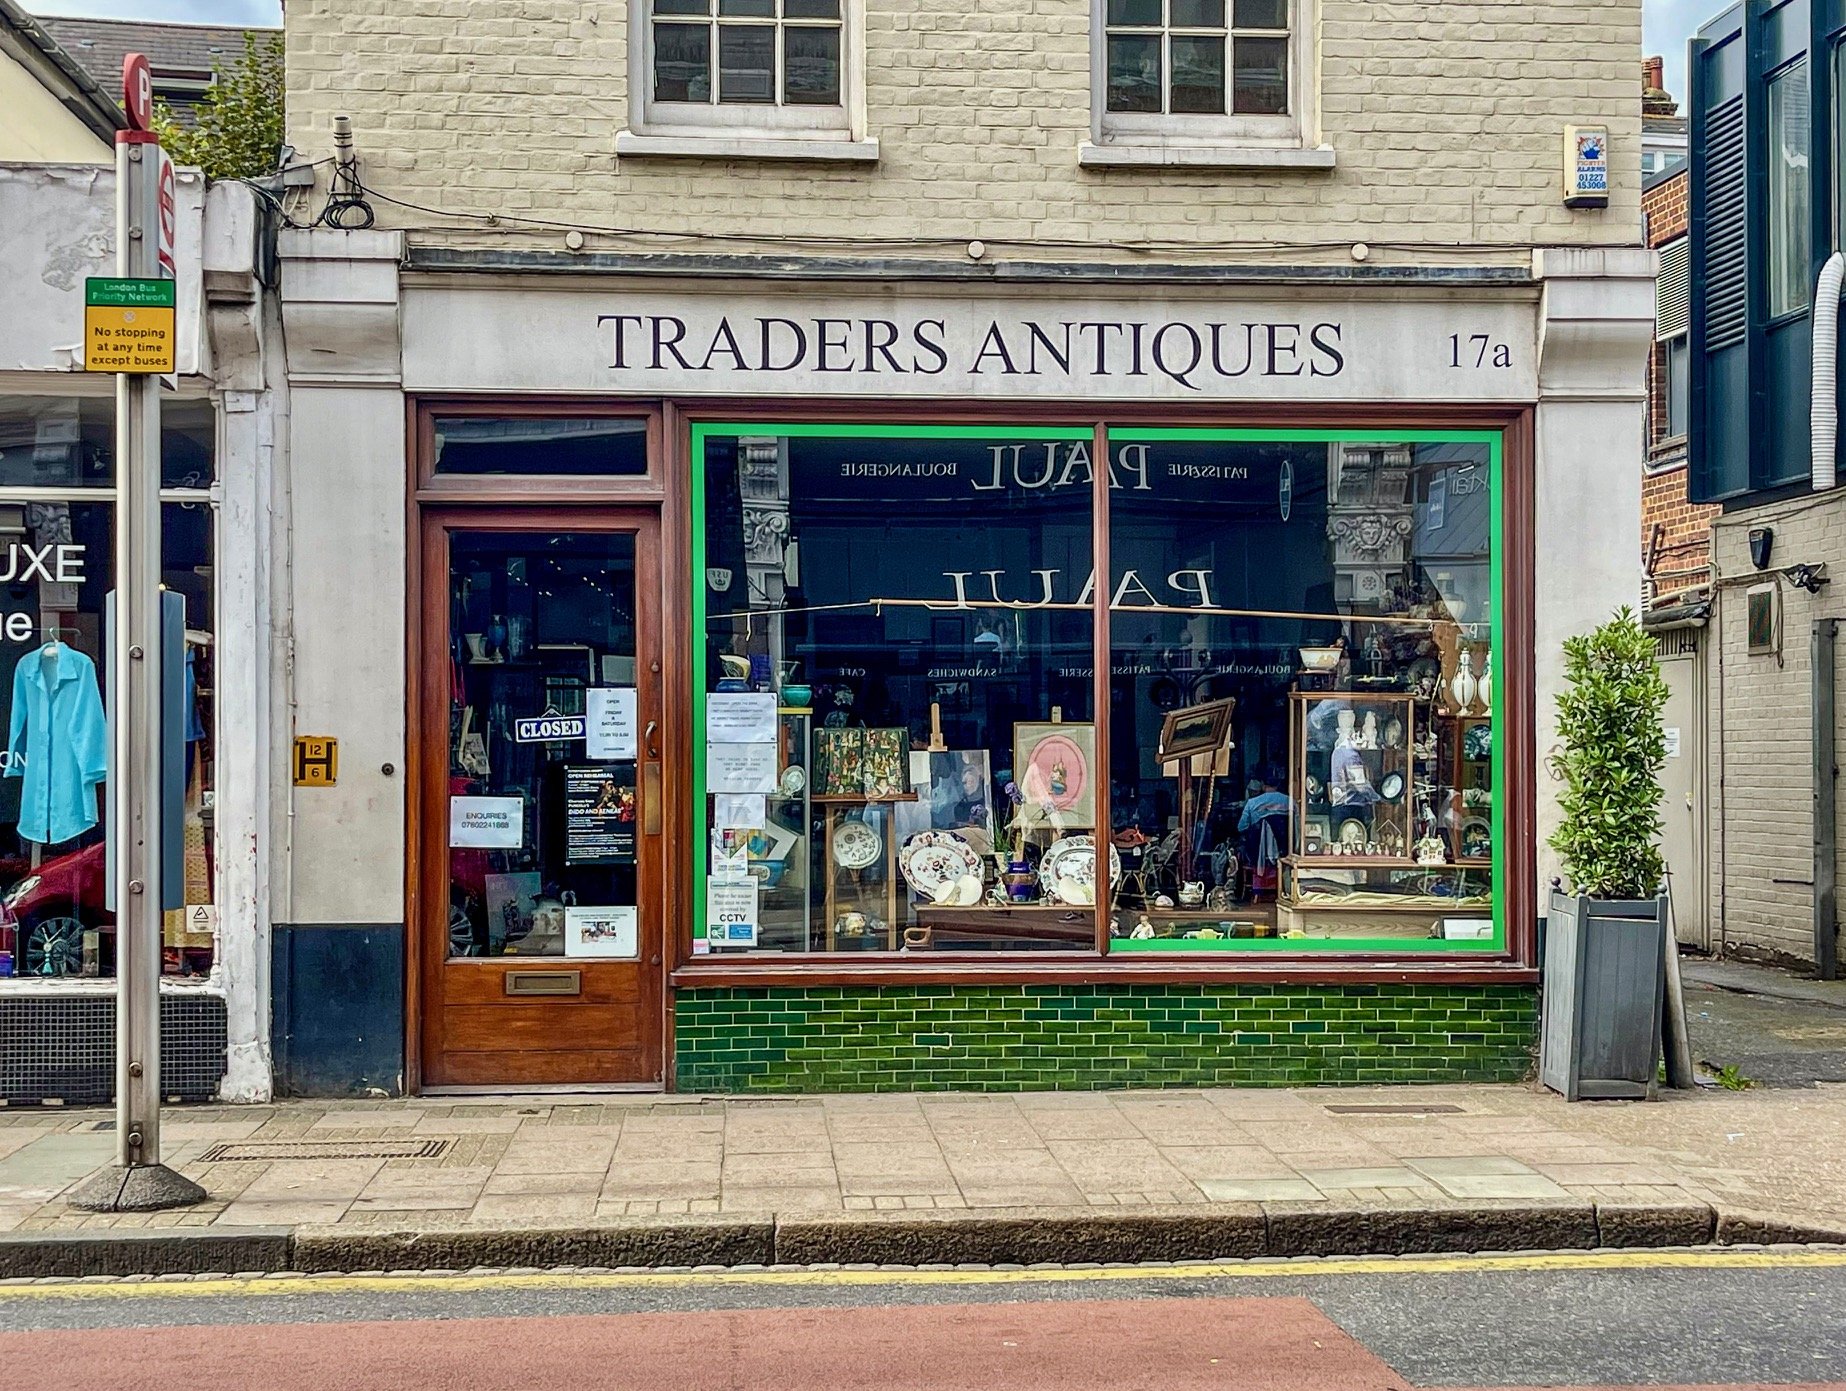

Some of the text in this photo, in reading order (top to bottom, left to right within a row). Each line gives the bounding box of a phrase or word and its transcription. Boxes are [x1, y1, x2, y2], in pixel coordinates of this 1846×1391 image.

[103, 283, 156, 292] London Bus
[92, 291, 167, 302] Priority Network
[94, 327, 166, 339] No stopping
[97, 342, 162, 353] at any time
[597, 315, 1344, 391] TRADERS ANTIQUES
[1448, 333, 1513, 369] 17a
[91, 355, 168, 366] except buses
[520, 720, 584, 738] CLOSED
[310, 745, 321, 755] 12
[299, 742, 332, 780] H
[311, 768, 320, 777] 6
[466, 812, 507, 820] ENQUIRIES
[719, 914, 746, 922] CCTV
